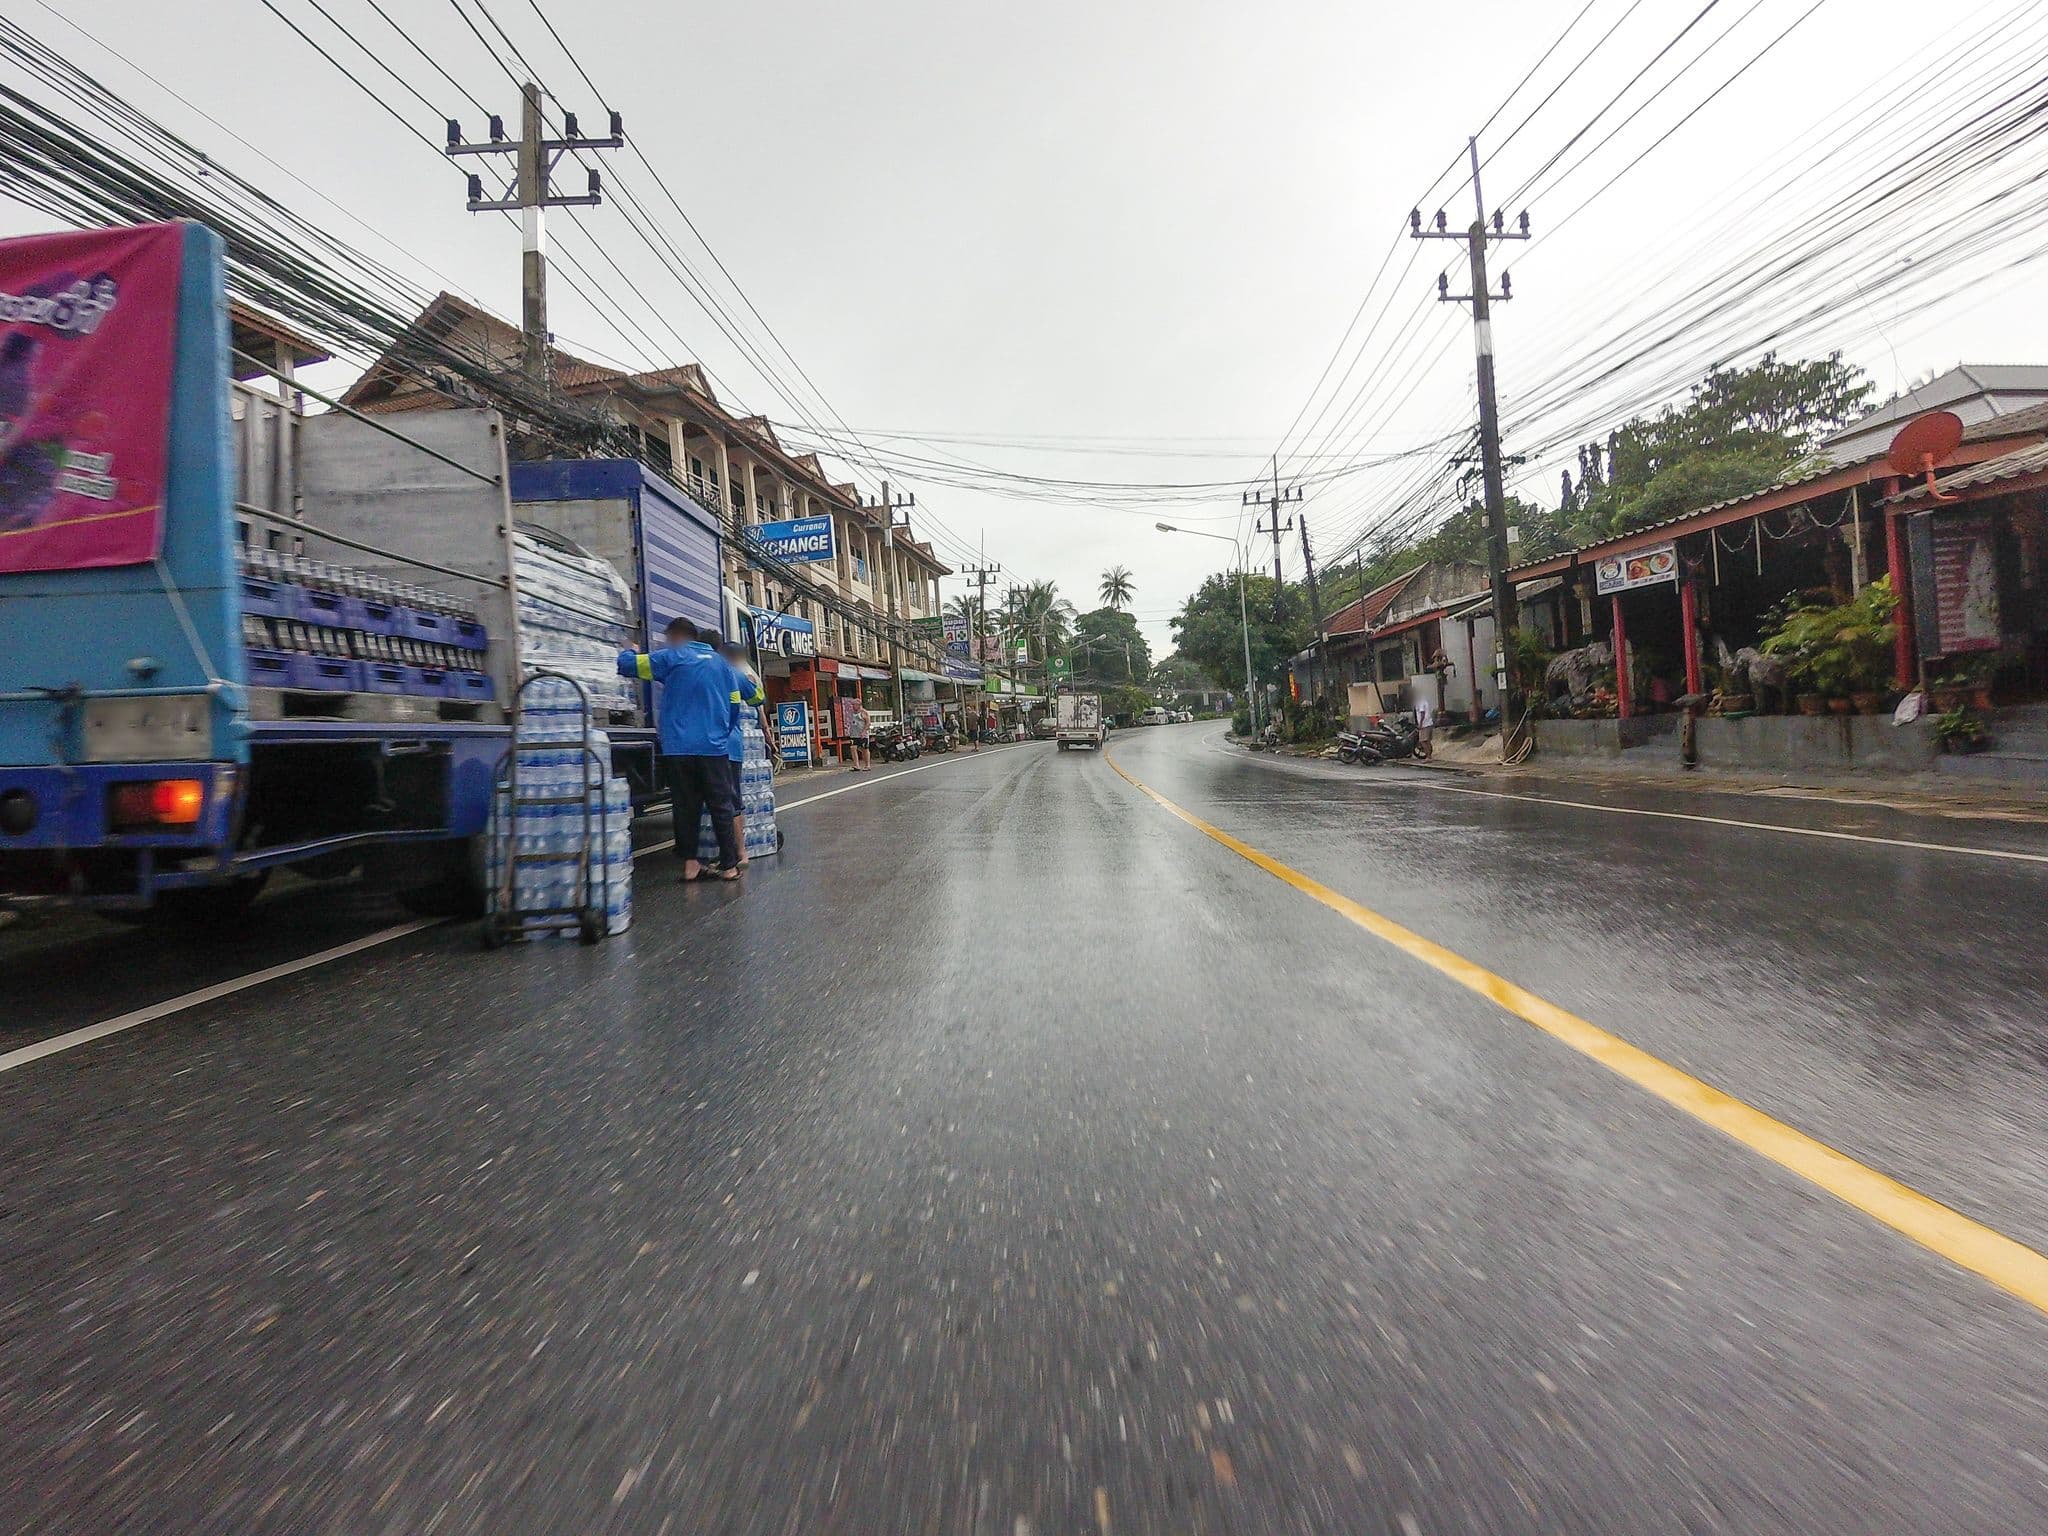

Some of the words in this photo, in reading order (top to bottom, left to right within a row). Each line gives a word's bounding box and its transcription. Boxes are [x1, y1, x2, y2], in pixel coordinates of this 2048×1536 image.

[793, 522, 827, 532] Currency
[763, 624, 814, 654] EXANGE
[780, 734, 806, 748] EXCHANGE
